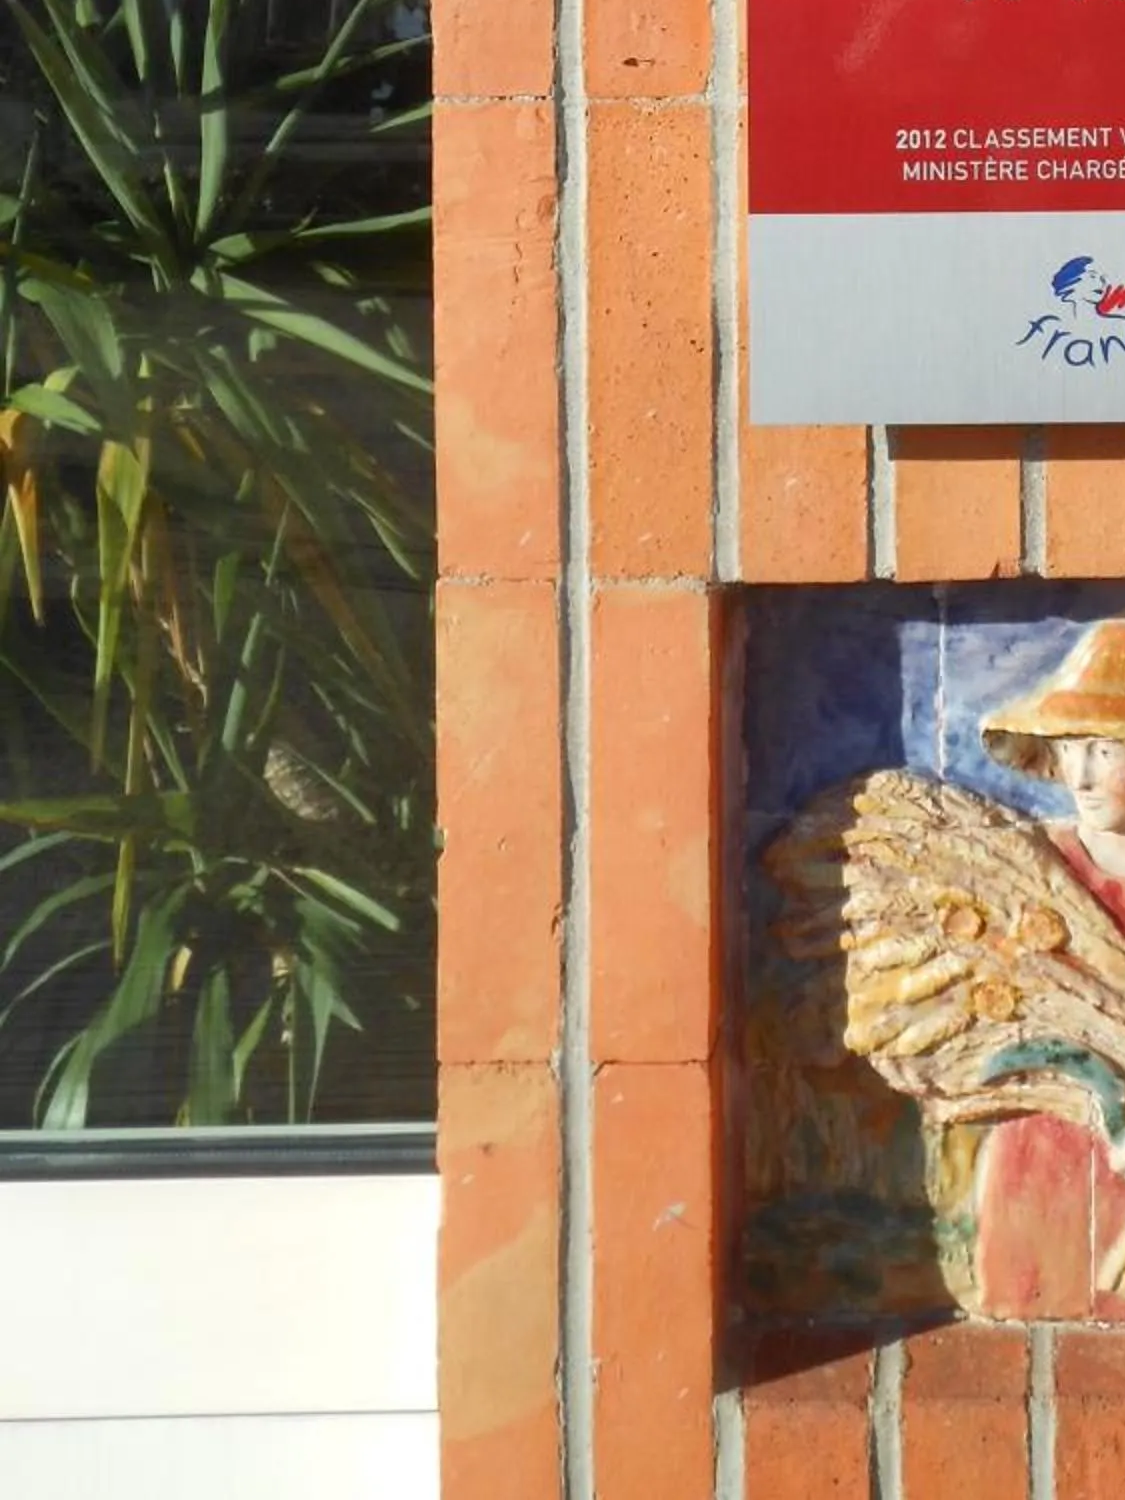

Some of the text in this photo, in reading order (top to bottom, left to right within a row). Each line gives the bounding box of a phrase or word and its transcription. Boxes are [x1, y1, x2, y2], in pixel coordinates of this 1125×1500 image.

[895, 129, 946, 149] 2012
[952, 127, 1112, 148] CLASSEMENT
[903, 155, 1028, 180] MINISTÈRE
